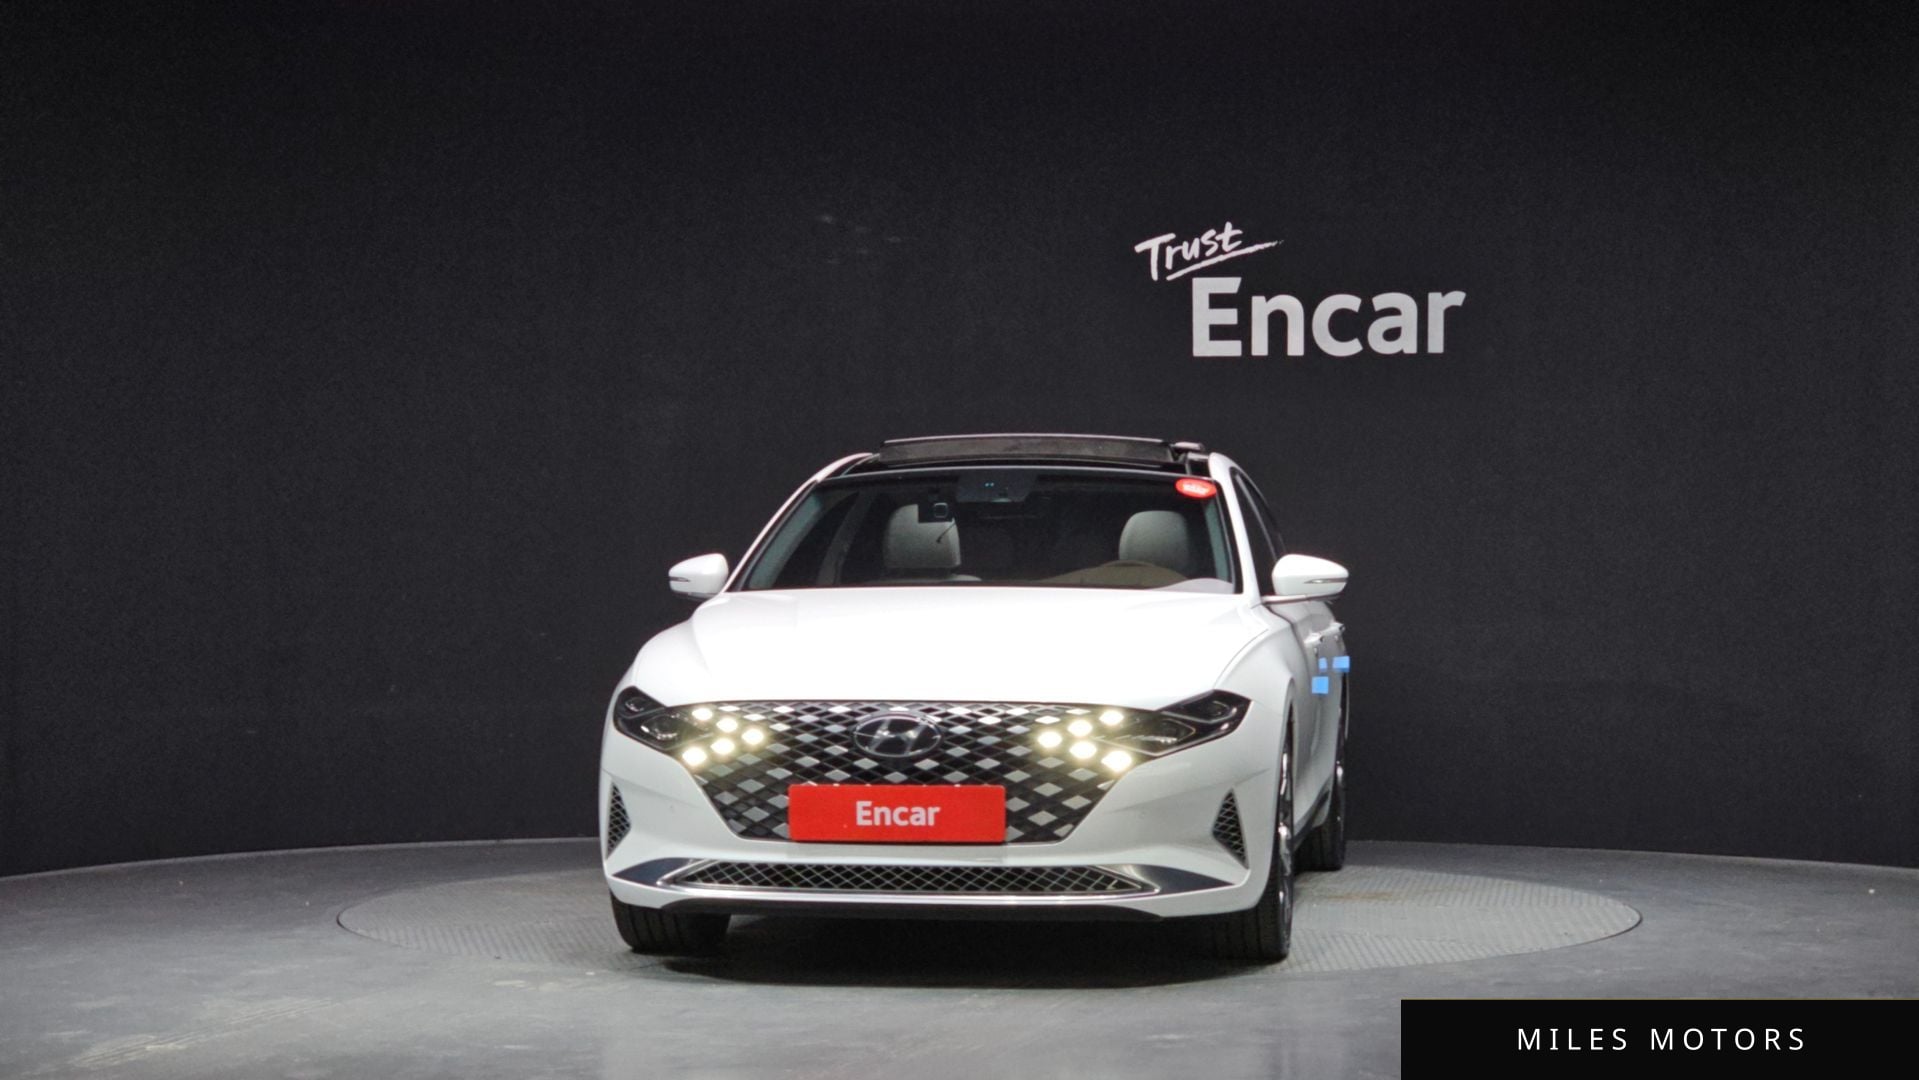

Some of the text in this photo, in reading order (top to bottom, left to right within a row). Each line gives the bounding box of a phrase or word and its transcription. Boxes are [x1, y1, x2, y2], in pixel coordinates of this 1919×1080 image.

[1134, 221, 1244, 282] Trust
[1191, 276, 1467, 357] Encar
[855, 800, 941, 827] Encar
